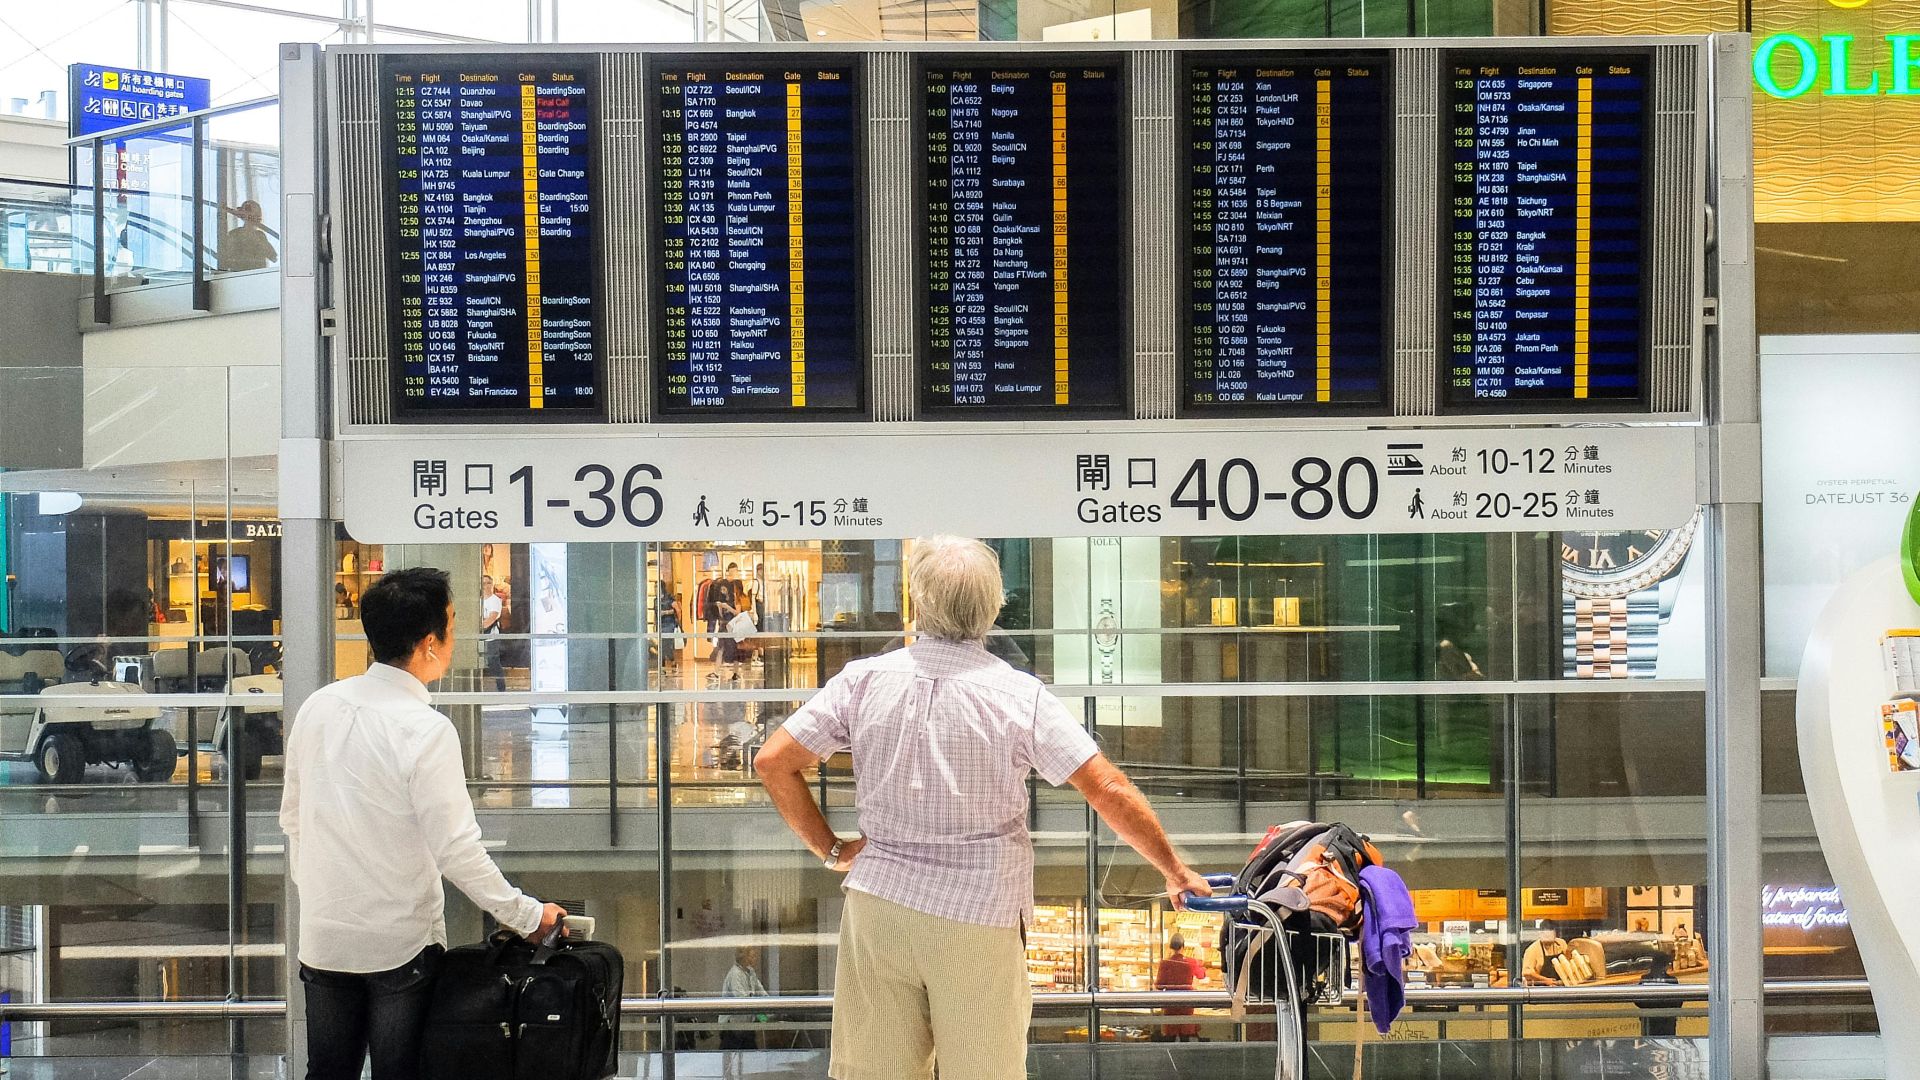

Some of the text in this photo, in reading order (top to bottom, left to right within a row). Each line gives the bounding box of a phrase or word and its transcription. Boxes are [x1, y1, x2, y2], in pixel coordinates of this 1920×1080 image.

[1481, 67, 1499, 75] Flight
[1518, 80, 1552, 89] Singapore
[133, 87, 164, 97] boarding
[460, 88, 495, 96] Quanzhou
[537, 87, 585, 96] BoardingSoon
[992, 85, 1014, 94] Beijing
[726, 110, 756, 118] Bangkok
[992, 109, 1017, 117] Nagoya
[1256, 118, 1294, 127] Tokyo/HND
[539, 135, 568, 143] Boarding
[484, 170, 510, 178] Lumpur
[557, 170, 584, 178] Change
[992, 179, 1025, 187] Surabaya
[1518, 197, 1547, 206] Taichung
[464, 206, 486, 214] Tianjin
[1256, 246, 1282, 255] Penang
[479, 252, 506, 260] Angeles
[729, 262, 765, 270] Chongqing
[994, 260, 1028, 268] Nanchang
[1516, 311, 1548, 320] Denpasar
[730, 352, 780, 361] Shanghai/PVG
[1257, 359, 1286, 368] Taichung
[1515, 378, 1544, 387] Bangkok
[1016, 385, 1041, 393] Lumpur
[1452, 446, 1600, 462] 約 分鐘
[1430, 449, 1611, 475] About 10-12 Minutes
[1077, 455, 1157, 491] 閘口
[413, 460, 494, 497] 閘口
[1077, 457, 1378, 523] Gates 40-80
[414, 464, 663, 529] Gates 1-36
[1453, 490, 1601, 506] 約 分鐘
[1806, 492, 1909, 504] DATEJUST 36
[739, 497, 868, 514] 約 分鐘
[1431, 493, 1614, 519] About 20-25 Minutes
[717, 501, 882, 527] About 5-15 Minutes
